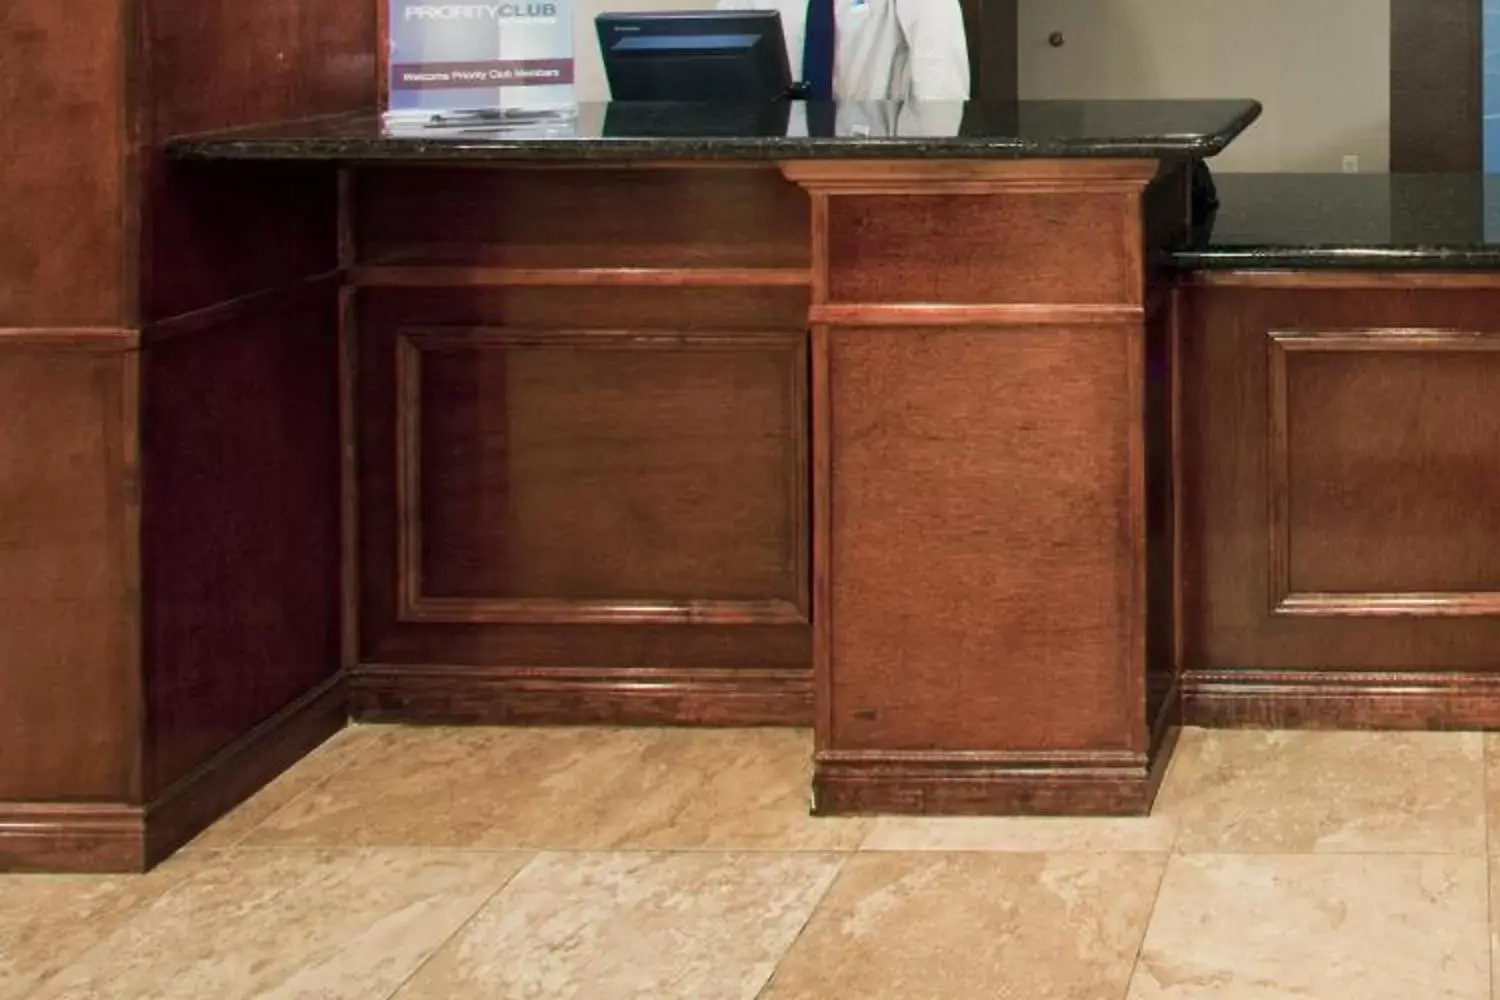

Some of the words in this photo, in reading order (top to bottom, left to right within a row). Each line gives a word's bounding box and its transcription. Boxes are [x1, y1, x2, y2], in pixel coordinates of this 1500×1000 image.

[403, 71, 450, 81] Welcome
[452, 70, 487, 81] Priority
[489, 69, 513, 80] Club
